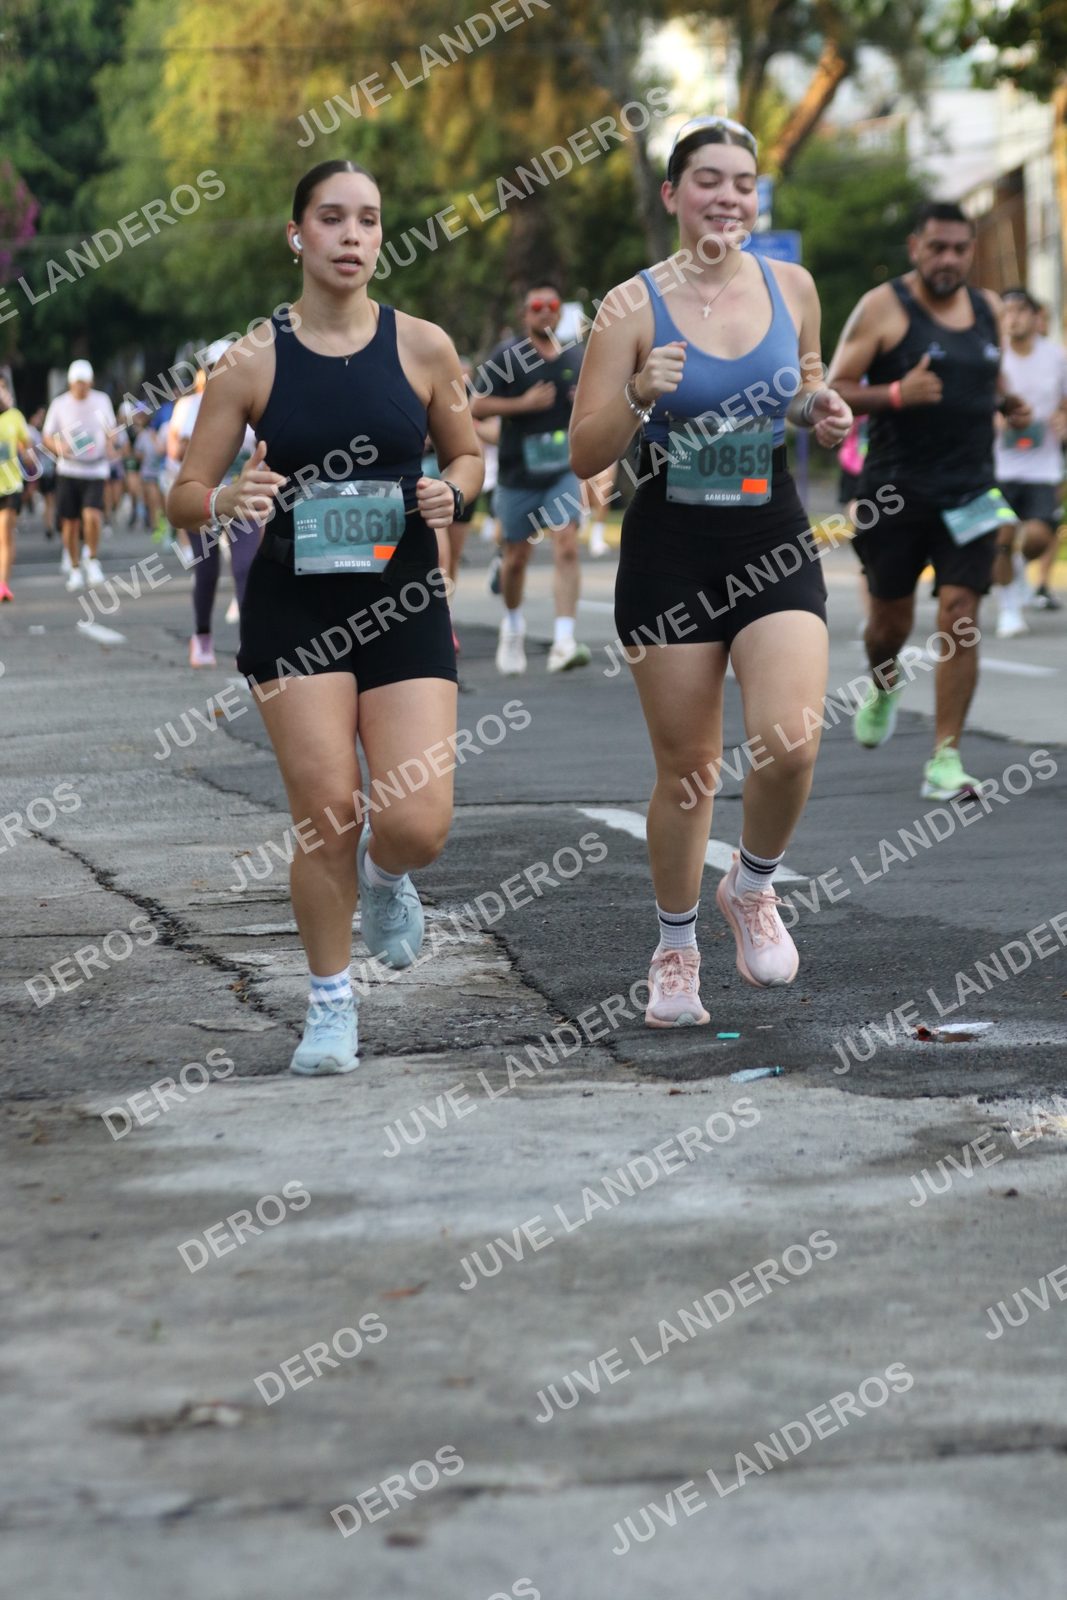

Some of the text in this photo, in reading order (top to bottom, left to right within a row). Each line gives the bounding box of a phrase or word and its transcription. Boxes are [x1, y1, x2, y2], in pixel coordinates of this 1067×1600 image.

[697, 442, 771, 477] 0859
[704, 493, 741, 502] SAMSUNG
[324, 508, 400, 544] 0861
[334, 560, 371, 568] SAMSUNG
